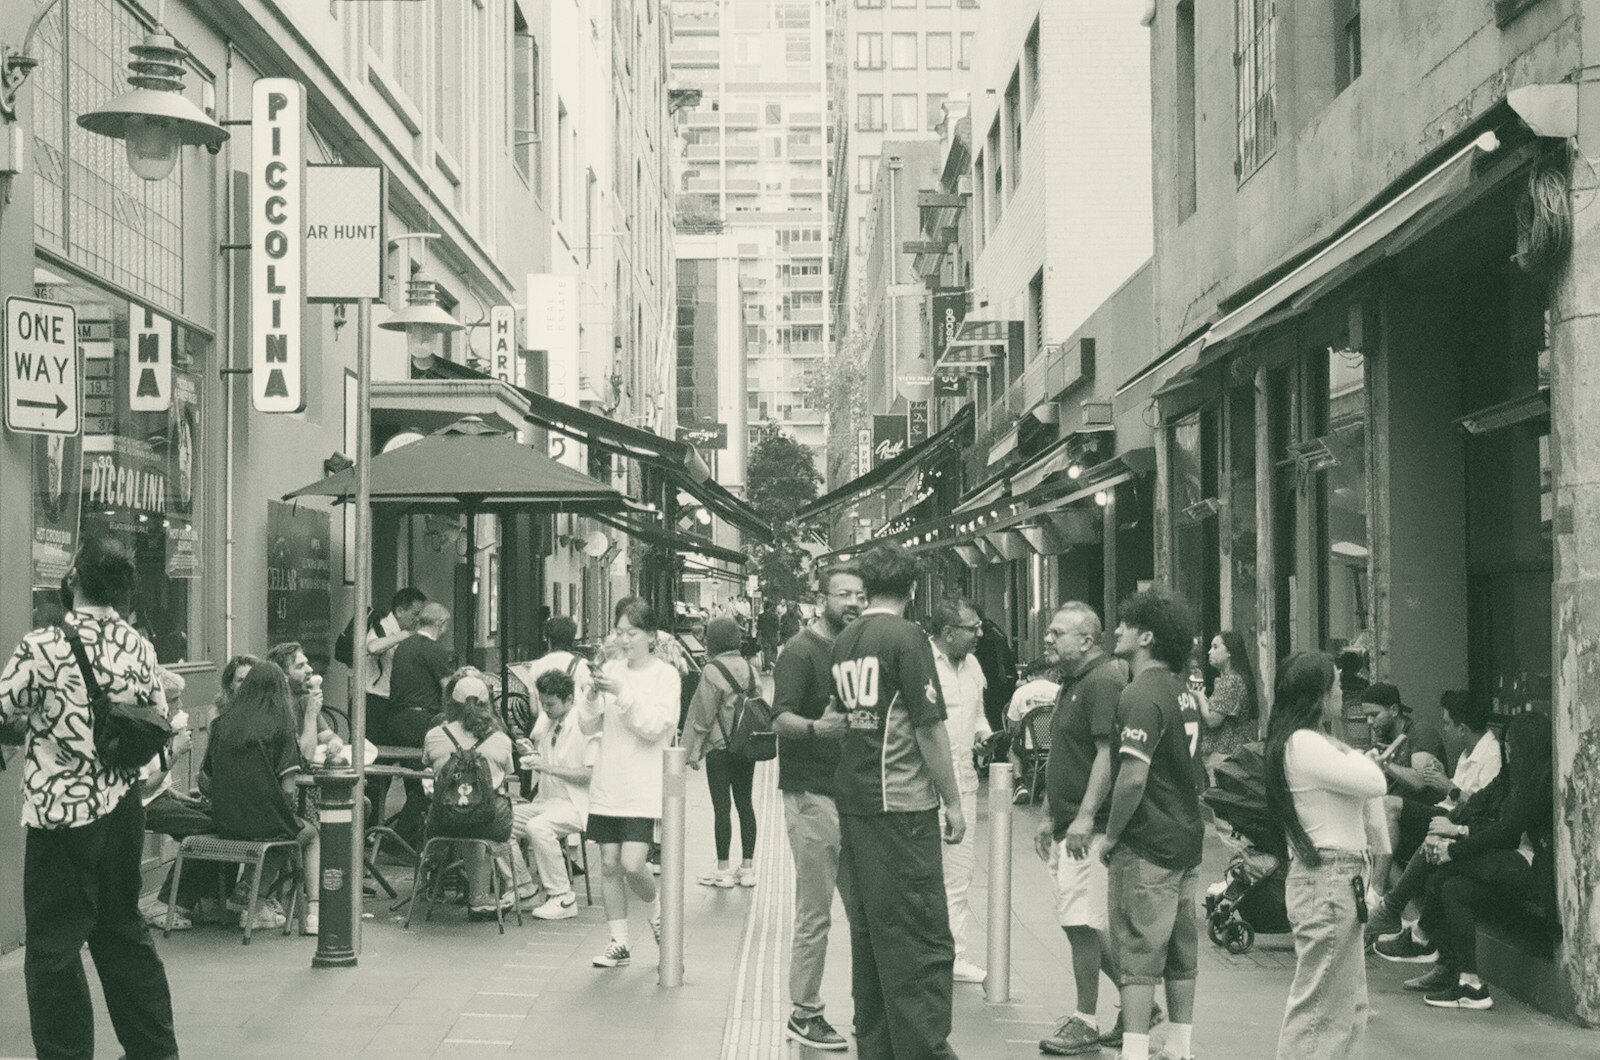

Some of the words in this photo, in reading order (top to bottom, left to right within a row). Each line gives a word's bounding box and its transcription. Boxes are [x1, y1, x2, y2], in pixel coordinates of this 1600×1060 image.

[264, 92, 290, 398] PICCOLINA
[306, 225, 328, 240] AR
[334, 224, 377, 240] HUNT
[17, 311, 65, 345] ONE
[14, 352, 69, 386] WAY
[89, 461, 166, 513] PICCOLINA
[1184, 721, 1199, 759] 7
